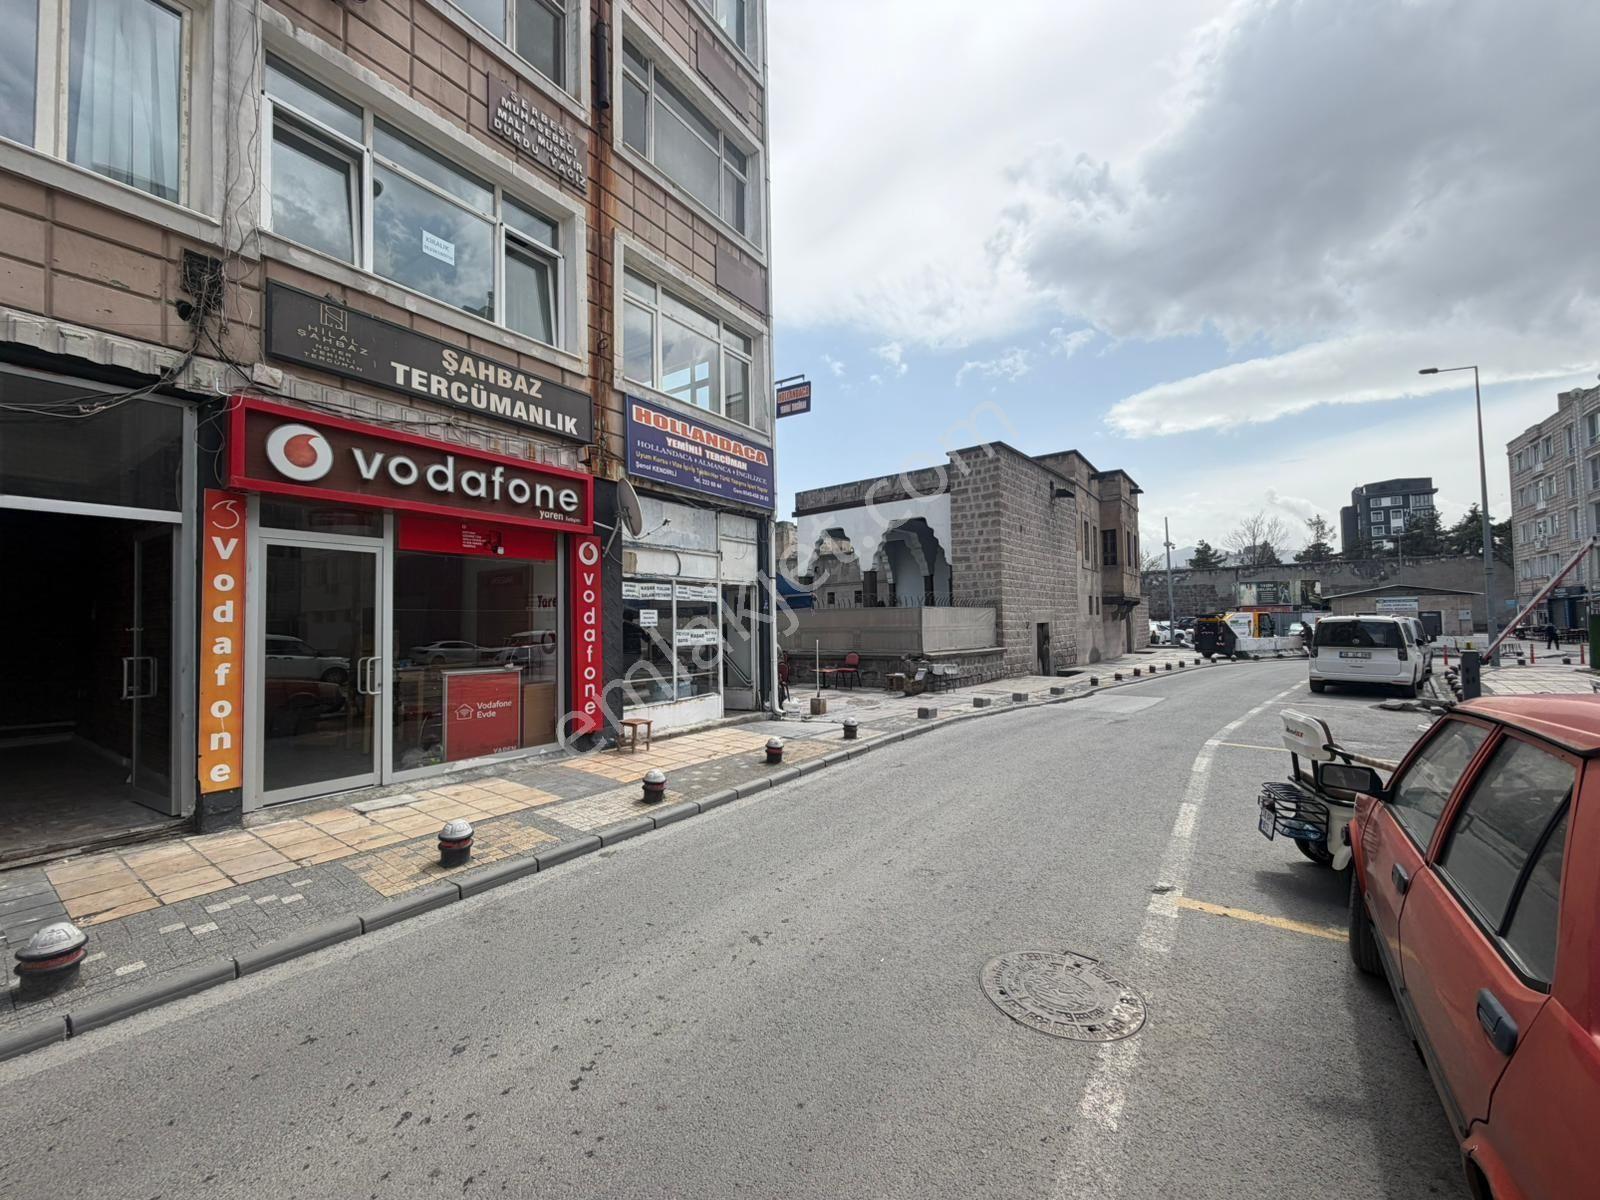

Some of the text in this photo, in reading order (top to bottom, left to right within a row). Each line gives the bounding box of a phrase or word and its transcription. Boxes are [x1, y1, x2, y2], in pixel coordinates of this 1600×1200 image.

[494, 118, 539, 154] DURDU
[510, 90, 572, 141] SERBEST
[390, 361, 578, 436] TERCÜMANLIK
[441, 349, 543, 399] ŞAHBAZ
[632, 404, 769, 467] HOLLANDACA
[637, 439, 693, 463] HOLLANDACA
[698, 458, 732, 475] ALMANCA
[351, 447, 579, 512] vodafone
[539, 508, 564, 520] yaren
[209, 536, 239, 783] vodafone
[583, 572, 597, 714] vodafone
[476, 700, 512, 711] Vodafone
[476, 710, 497, 719] Evde
